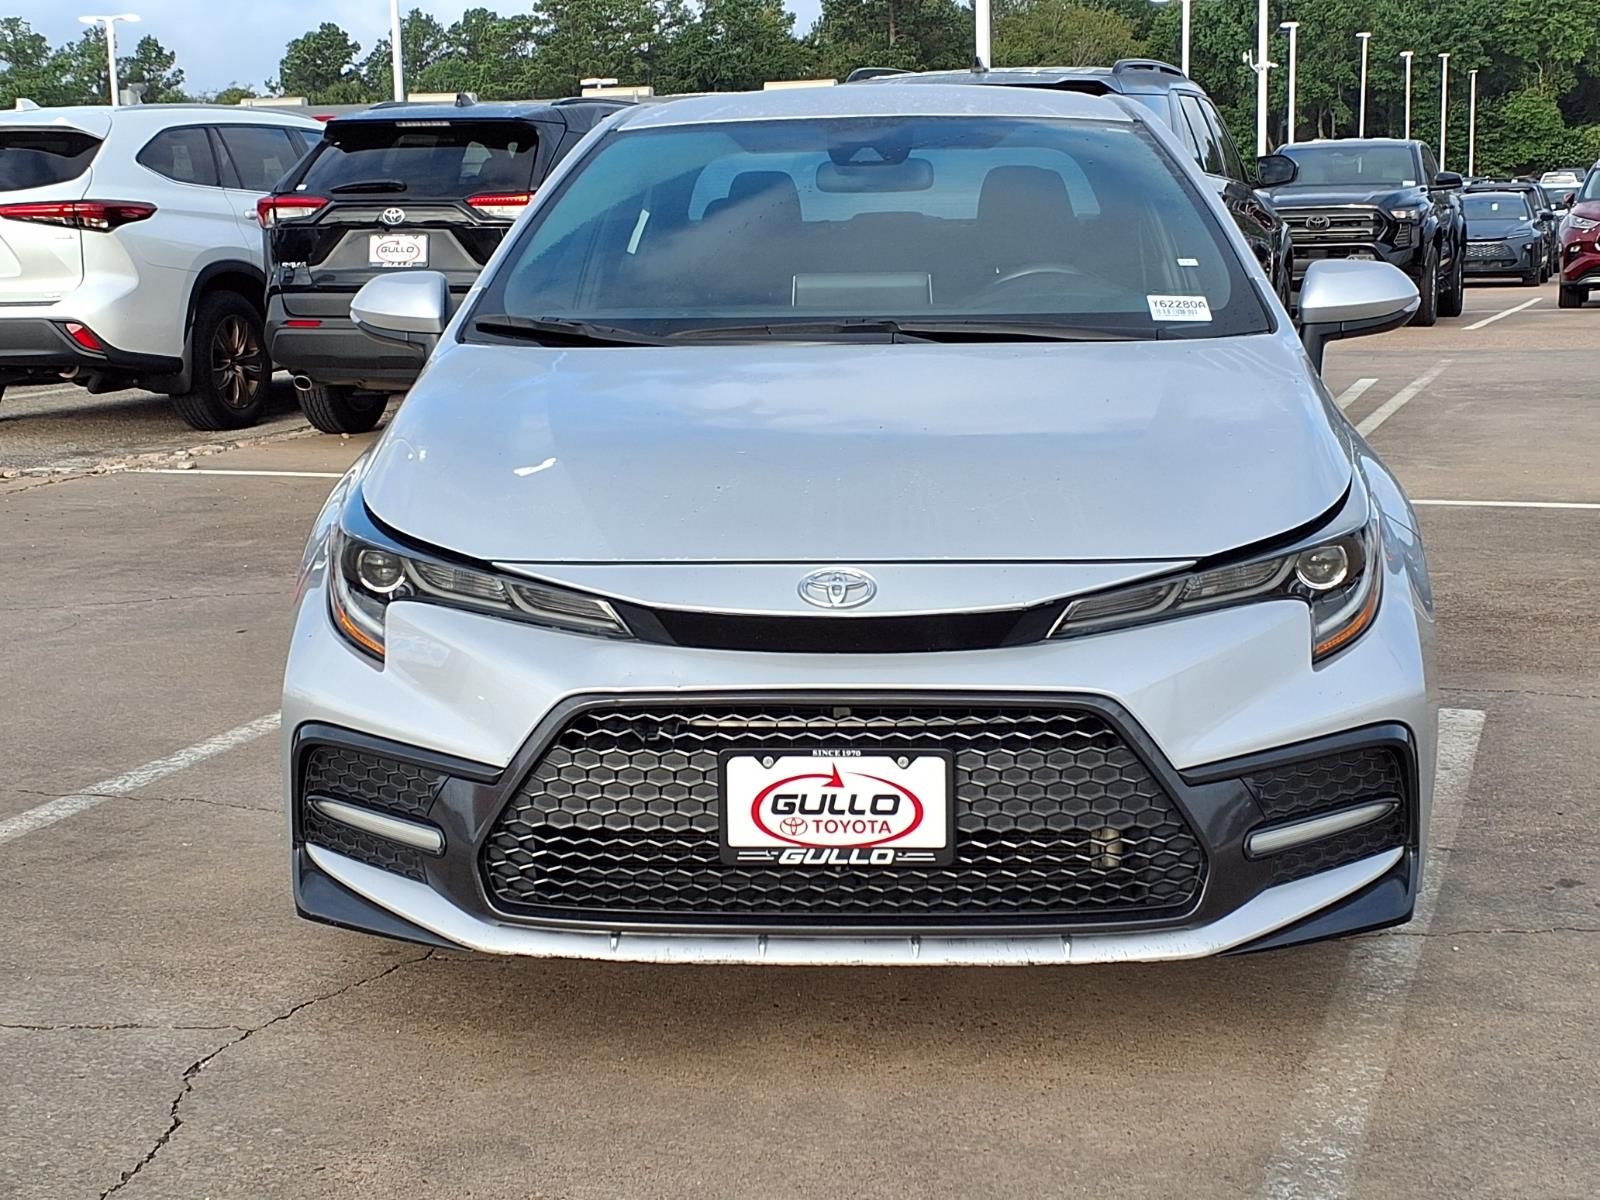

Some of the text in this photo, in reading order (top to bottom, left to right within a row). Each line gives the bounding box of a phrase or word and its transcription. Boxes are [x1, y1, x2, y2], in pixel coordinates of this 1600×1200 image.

[1152, 299, 1207, 309] Y62280A
[812, 749, 861, 757] SINCE 1970
[770, 794, 901, 815] GULLO
[812, 819, 892, 834] TOYOTA
[778, 848, 895, 865] GULLO
